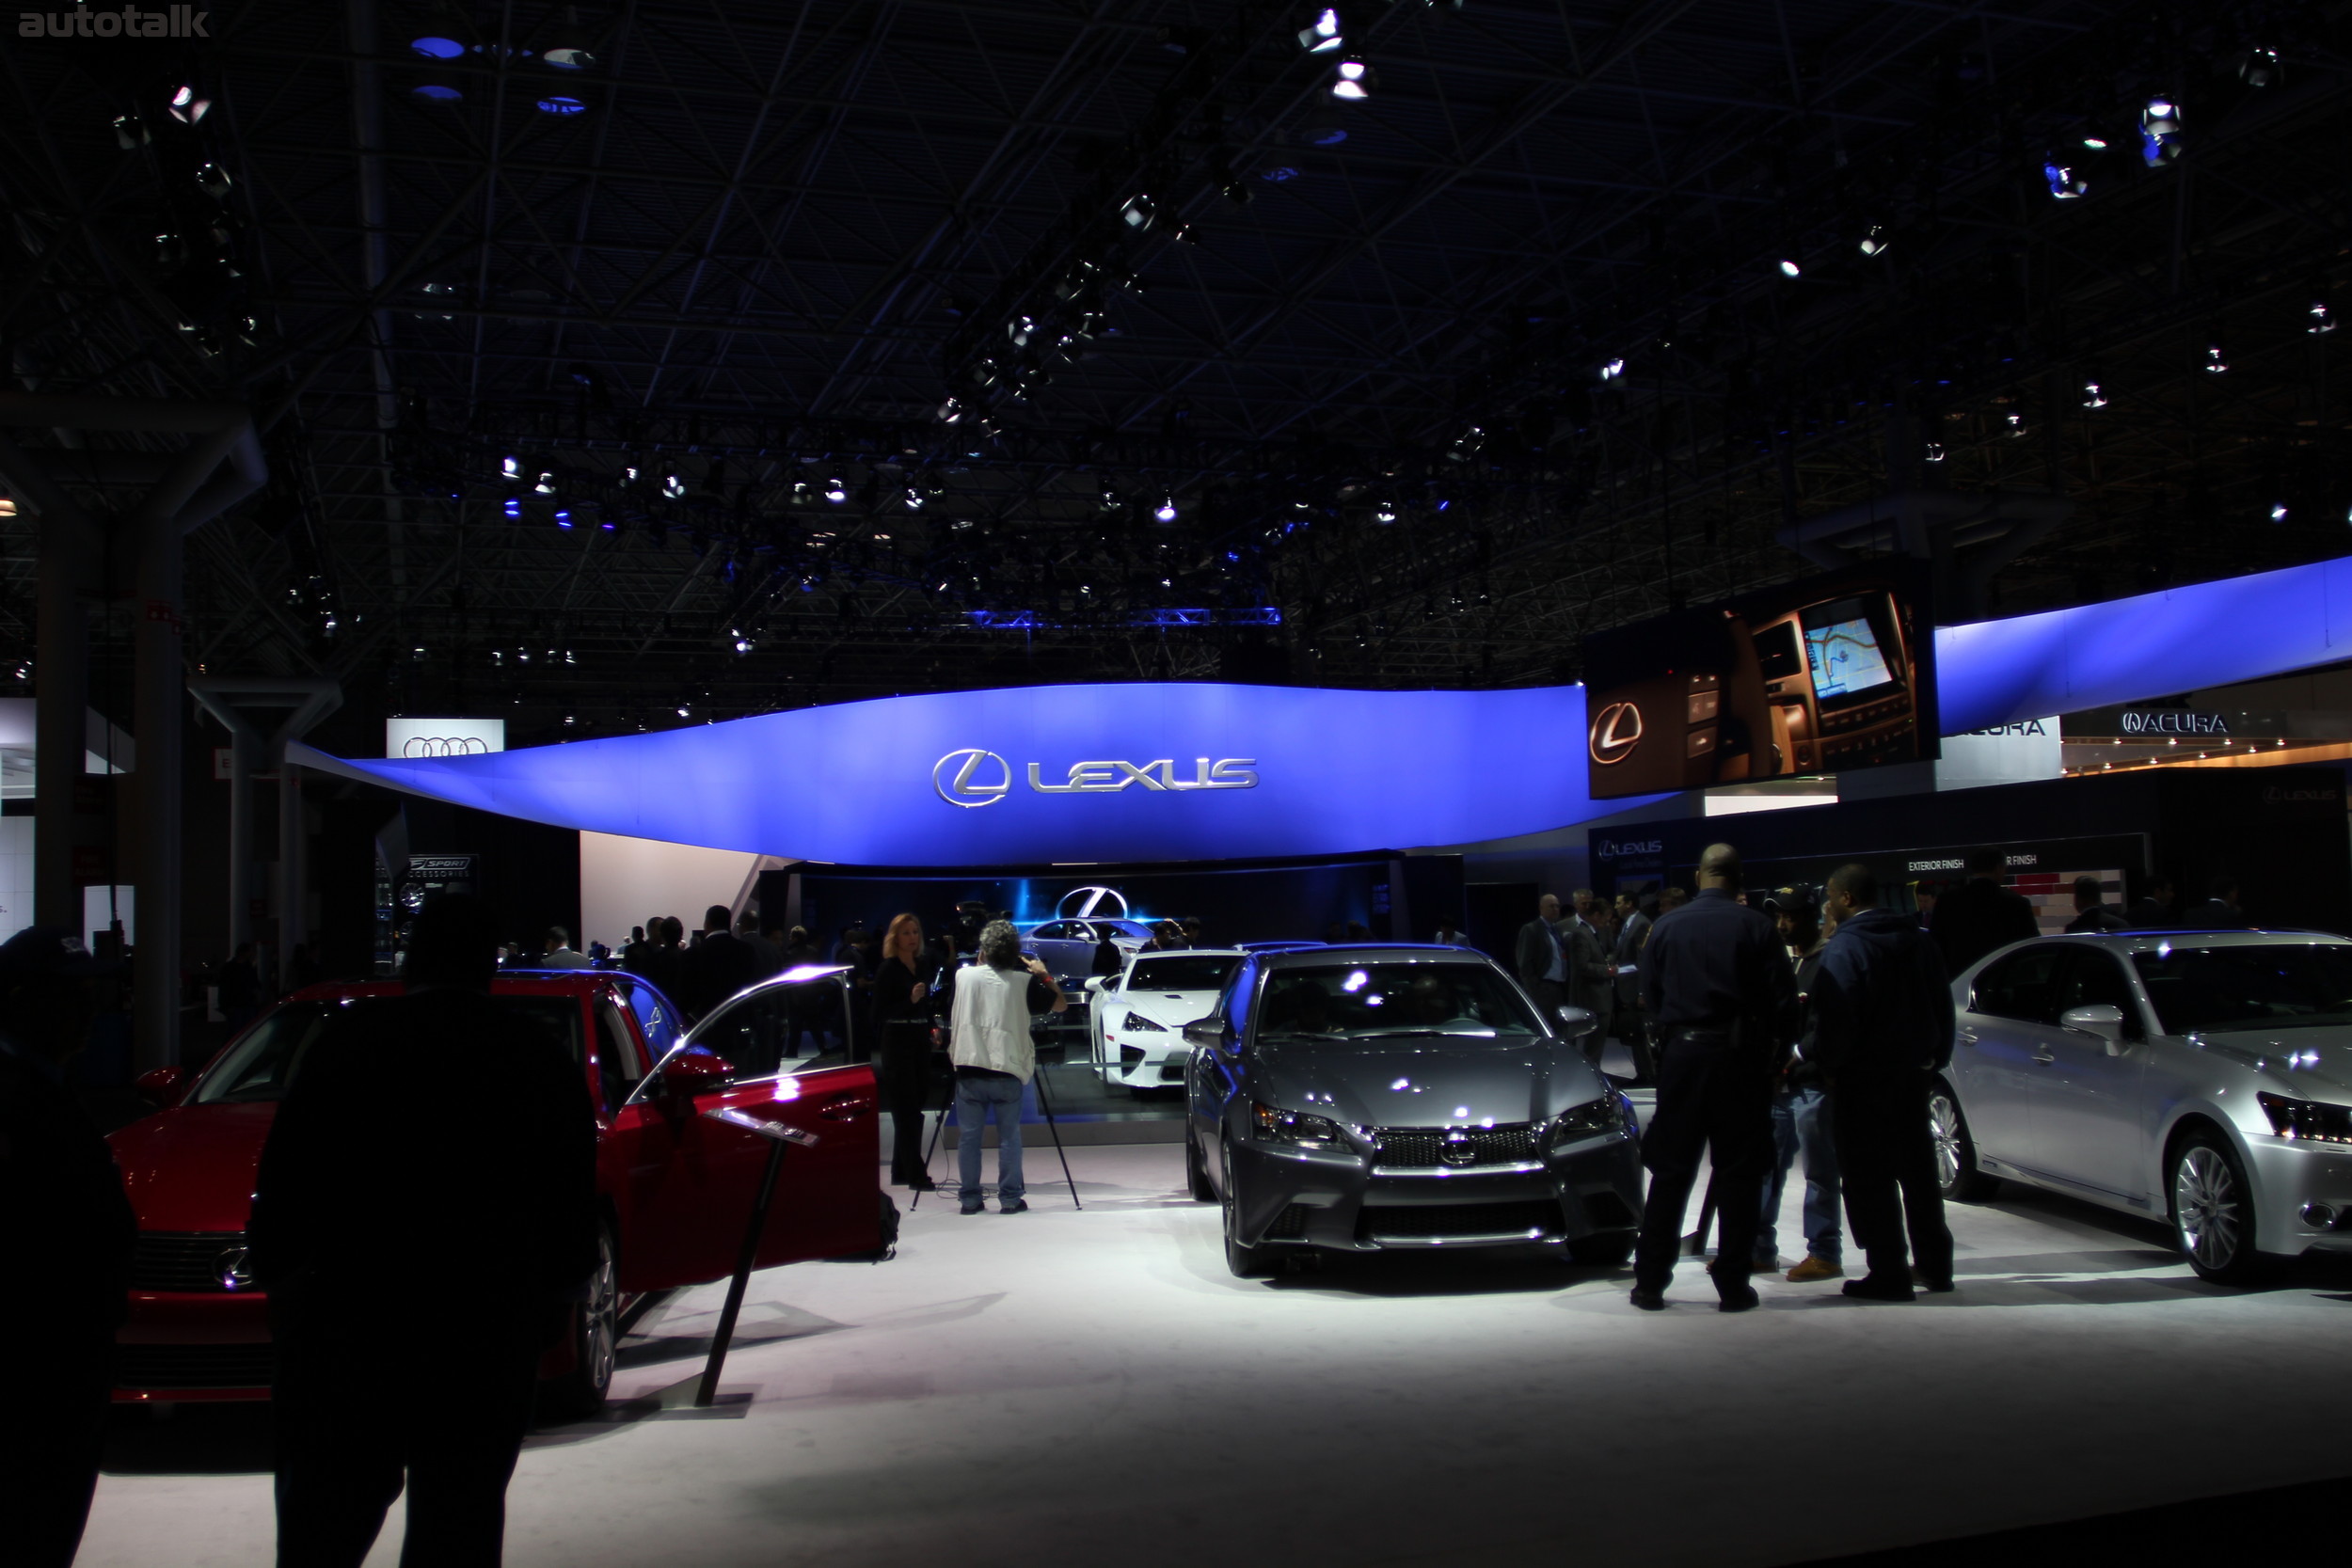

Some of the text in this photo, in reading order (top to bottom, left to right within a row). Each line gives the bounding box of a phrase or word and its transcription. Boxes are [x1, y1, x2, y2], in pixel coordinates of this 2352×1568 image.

[2140, 713, 2229, 732] ACURA
[1027, 756, 1260, 793] LEXUS
[2283, 789, 2338, 801] LEXUS
[1615, 840, 1663, 856] LEXUS
[1908, 859, 1964, 871] EXTERIOR FINISH
[2012, 854, 2037, 865] FINISH
